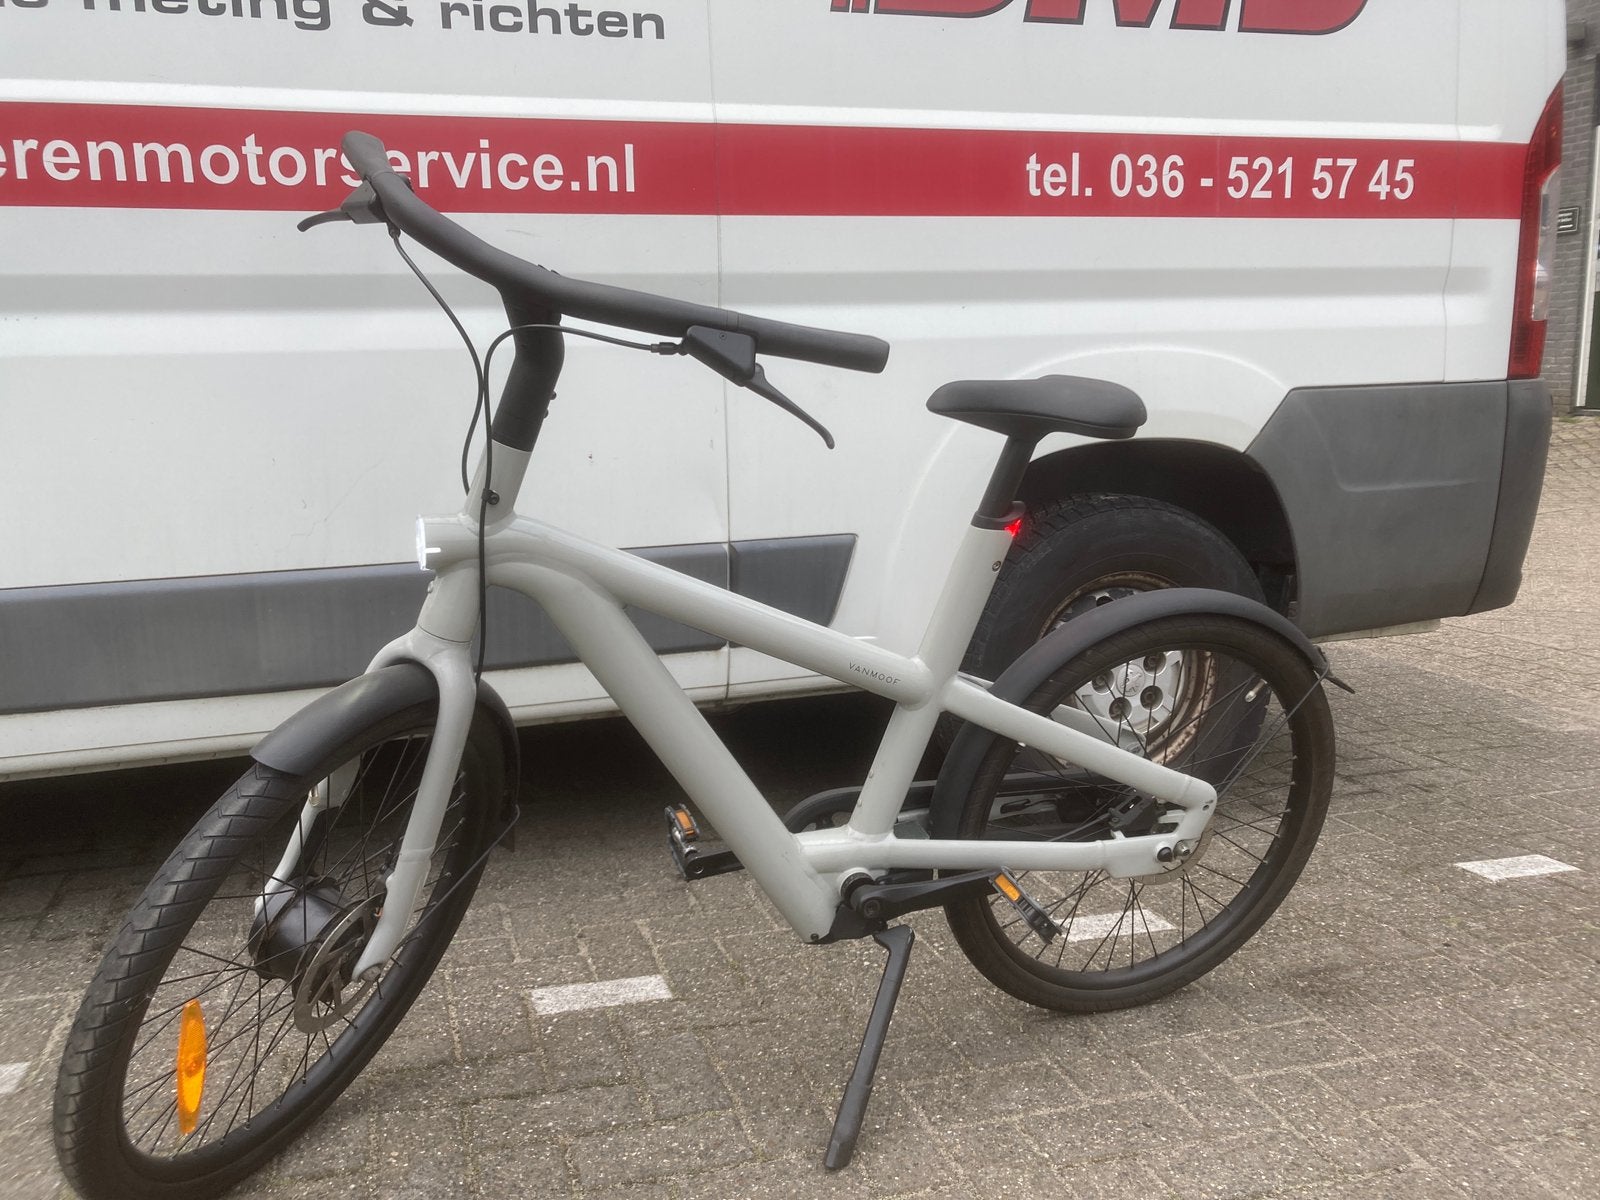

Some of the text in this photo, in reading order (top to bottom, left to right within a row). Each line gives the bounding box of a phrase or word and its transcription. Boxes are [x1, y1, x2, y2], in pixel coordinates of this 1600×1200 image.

[362, 0, 414, 27] &
[440, 0, 665, 39] richten
[0, 133, 635, 192] renmotorservice.nl
[1026, 153, 1415, 200] tel. 036 - 521 57 45
[848, 661, 901, 685] VANMOOF
